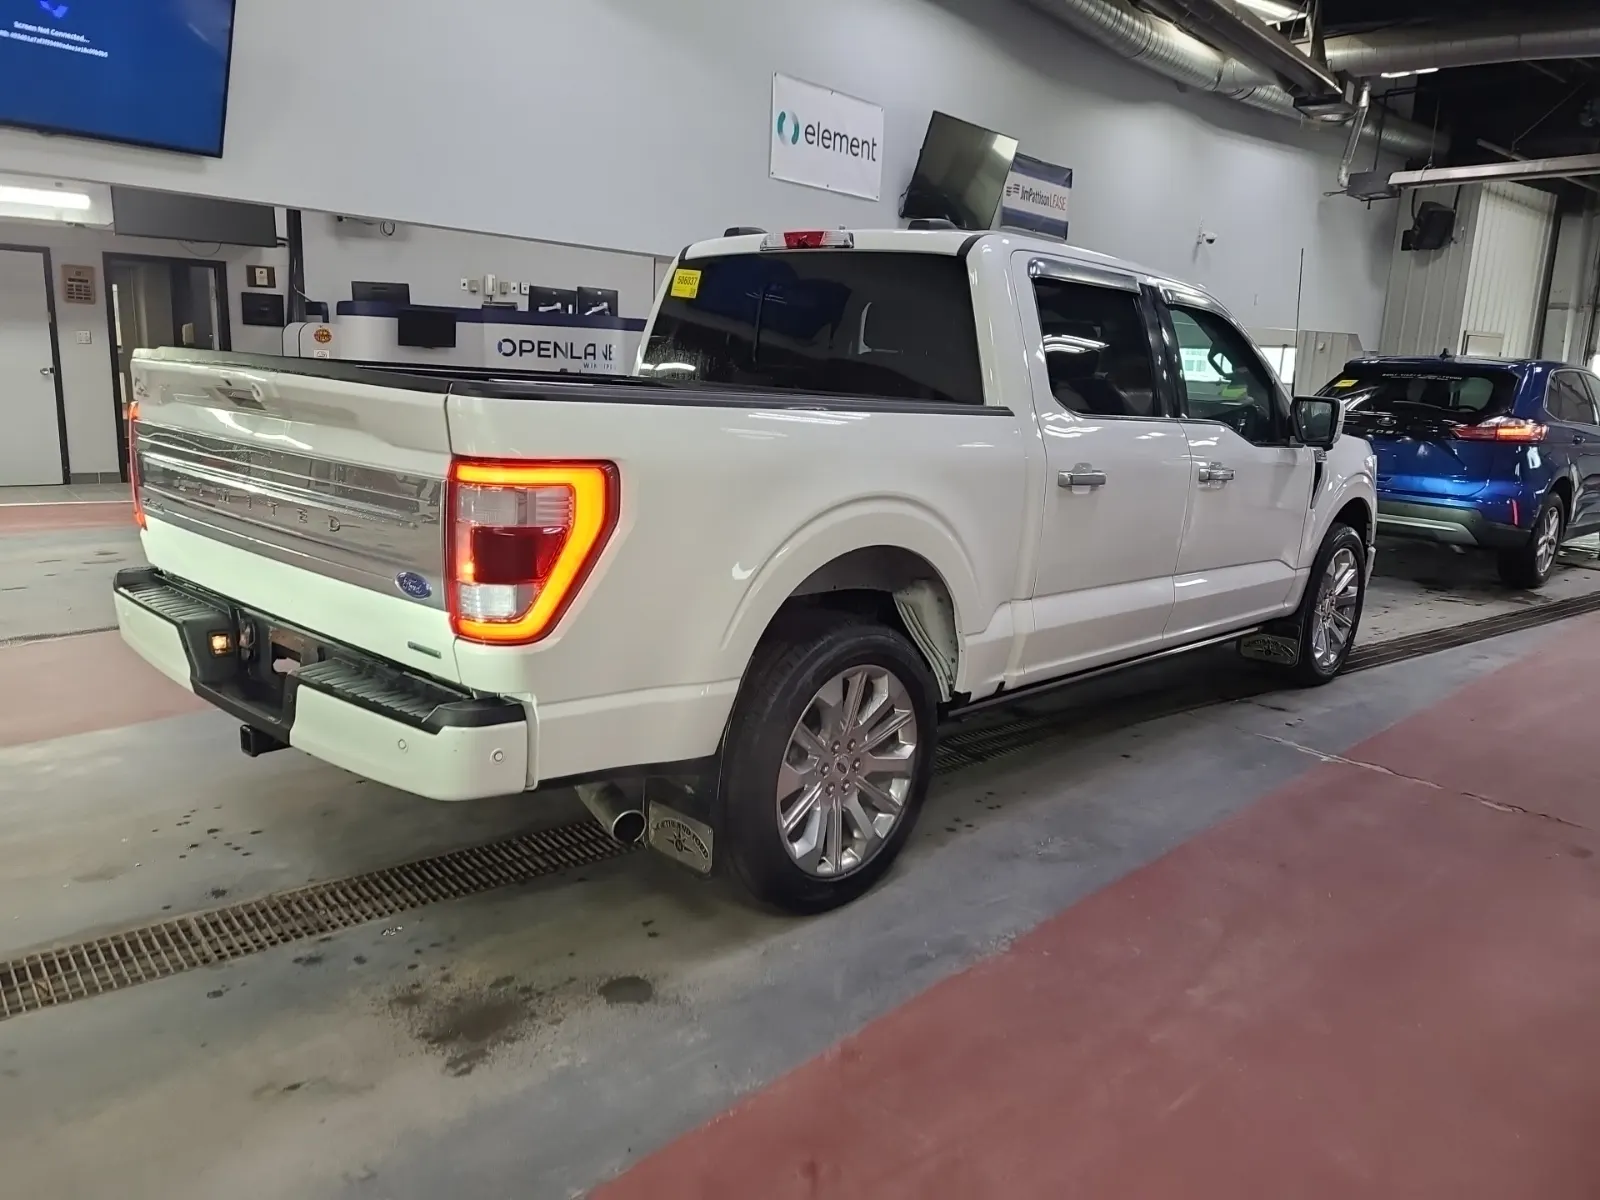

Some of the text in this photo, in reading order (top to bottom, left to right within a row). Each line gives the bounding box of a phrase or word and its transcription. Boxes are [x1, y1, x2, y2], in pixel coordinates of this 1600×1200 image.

[14, 20, 37, 32] Screen
[38, 26, 50, 35] Not
[804, 122, 877, 162] element
